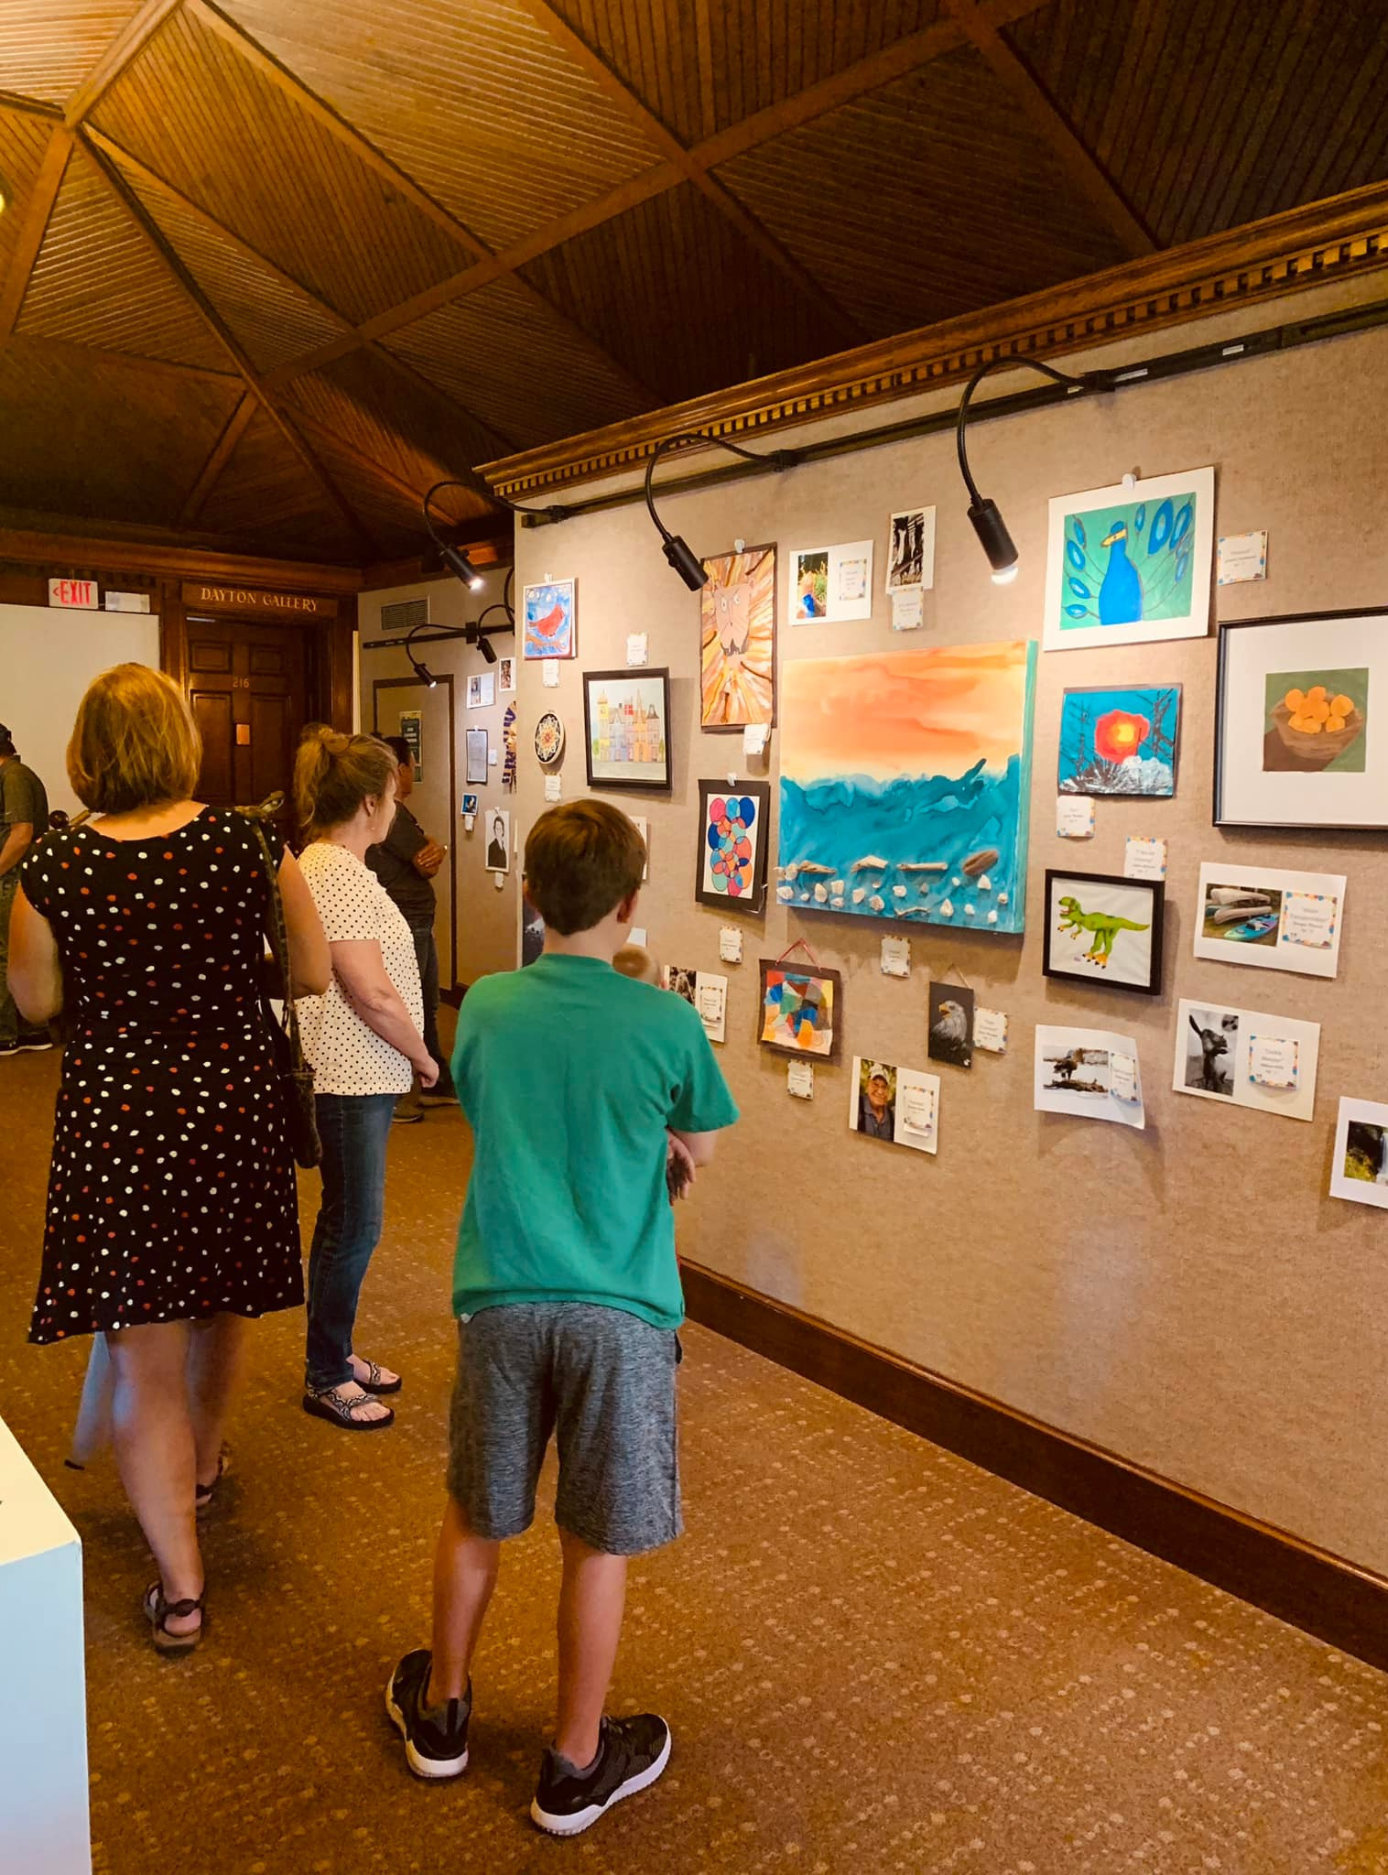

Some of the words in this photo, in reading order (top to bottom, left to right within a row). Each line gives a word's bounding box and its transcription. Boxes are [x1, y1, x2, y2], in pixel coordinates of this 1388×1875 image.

[60, 580, 91, 605] EXIT
[201, 587, 257, 604] DAYTON
[262, 594, 318, 612] GALLERY
[232, 676, 250, 688] 216
